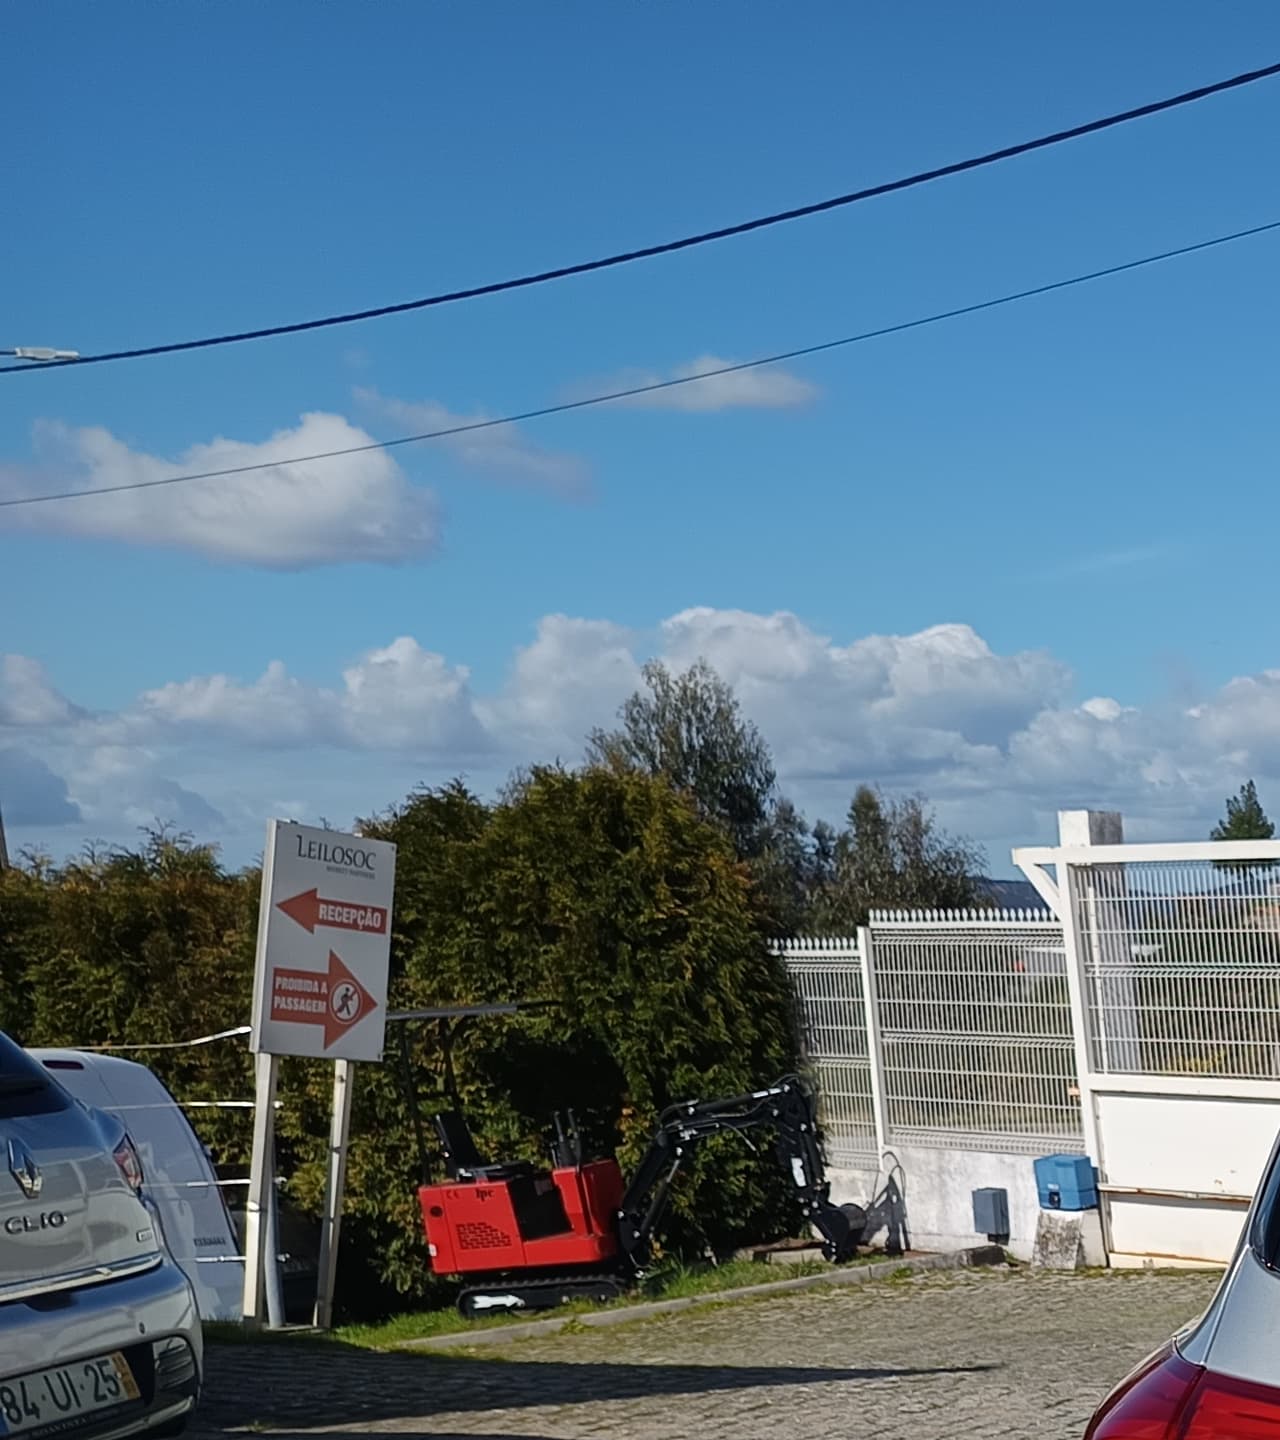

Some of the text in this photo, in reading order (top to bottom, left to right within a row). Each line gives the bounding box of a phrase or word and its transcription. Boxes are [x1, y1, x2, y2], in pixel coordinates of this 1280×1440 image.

[296, 834, 377, 871] LEILOSOC
[318, 902, 382, 930] RECEPÇÃO
[275, 975, 328, 994] PROIBIDA A
[273, 995, 327, 1014] PASSAGEM
[4, 1210, 65, 1235] CLIO
